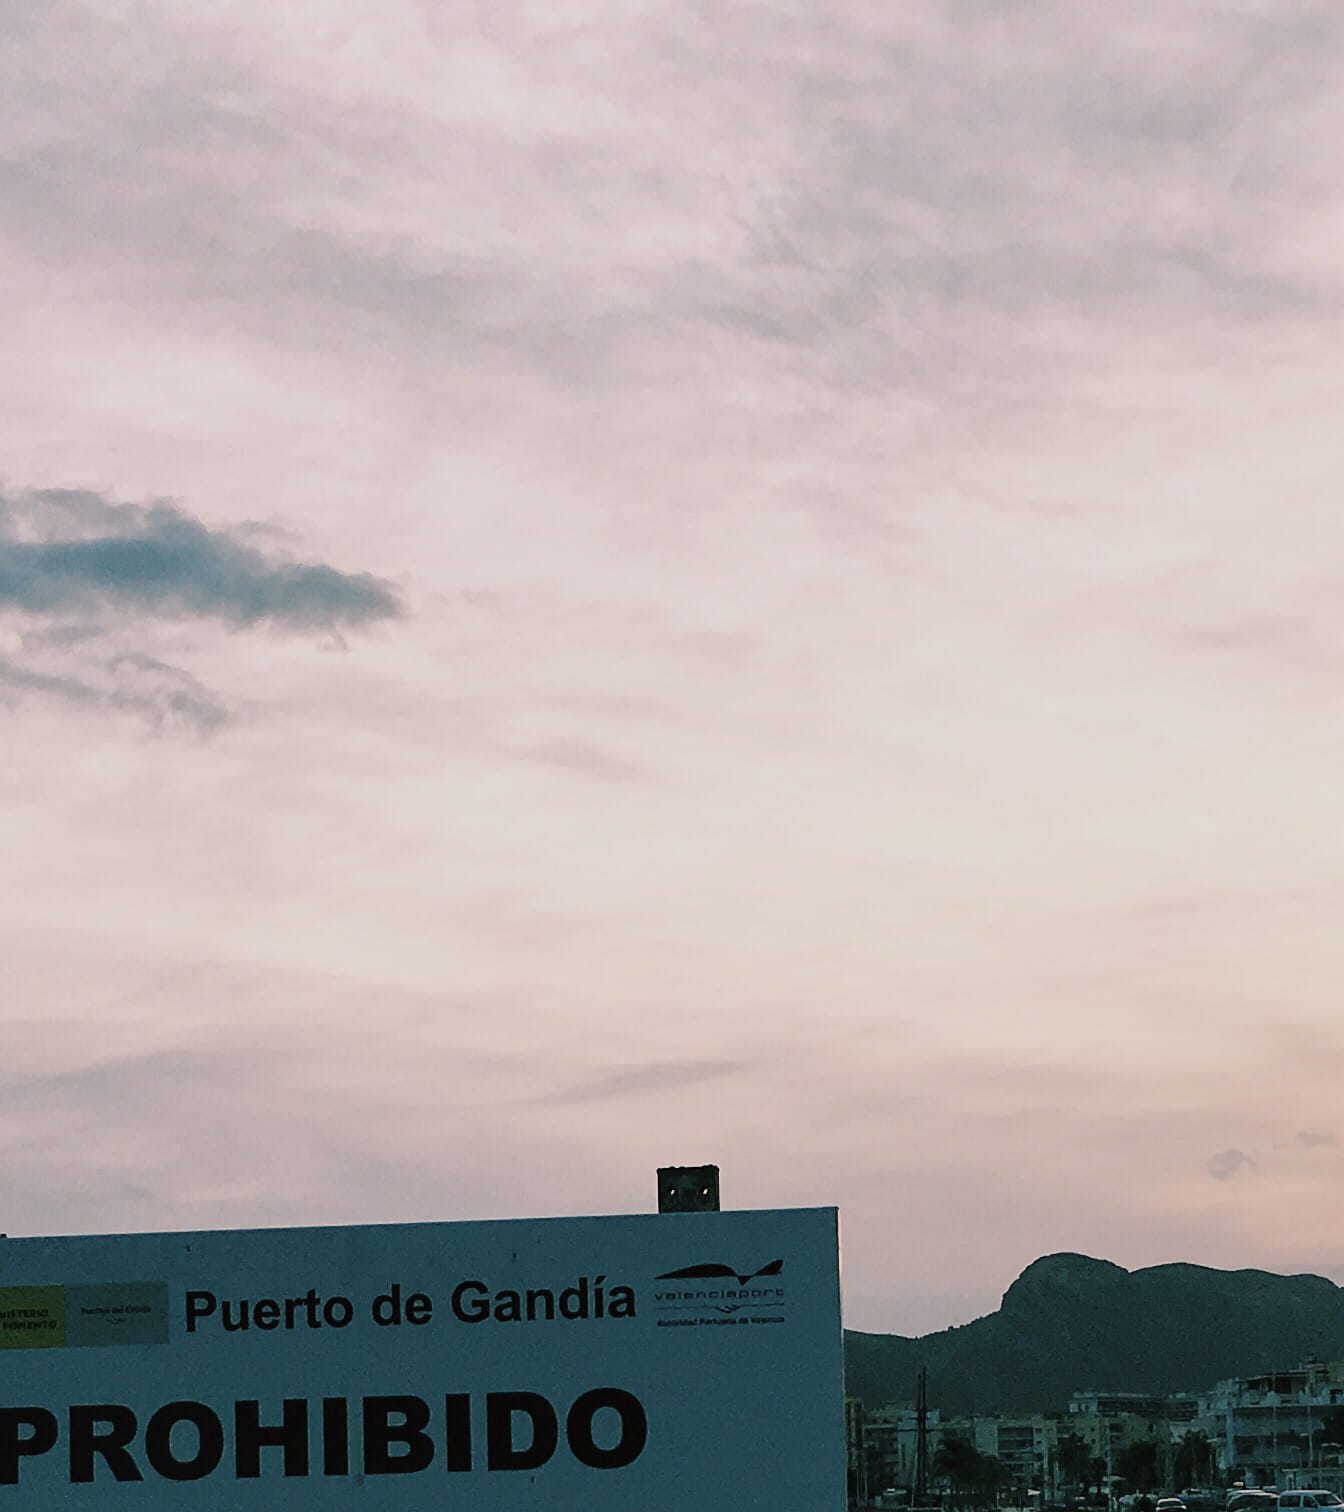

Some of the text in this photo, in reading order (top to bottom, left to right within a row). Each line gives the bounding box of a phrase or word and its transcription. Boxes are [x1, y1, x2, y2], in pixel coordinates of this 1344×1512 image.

[654, 1288, 784, 1300] valenciaport
[186, 1276, 635, 1332] Puerto de Gandía
[3, 1319, 58, 1331] FOMENTO
